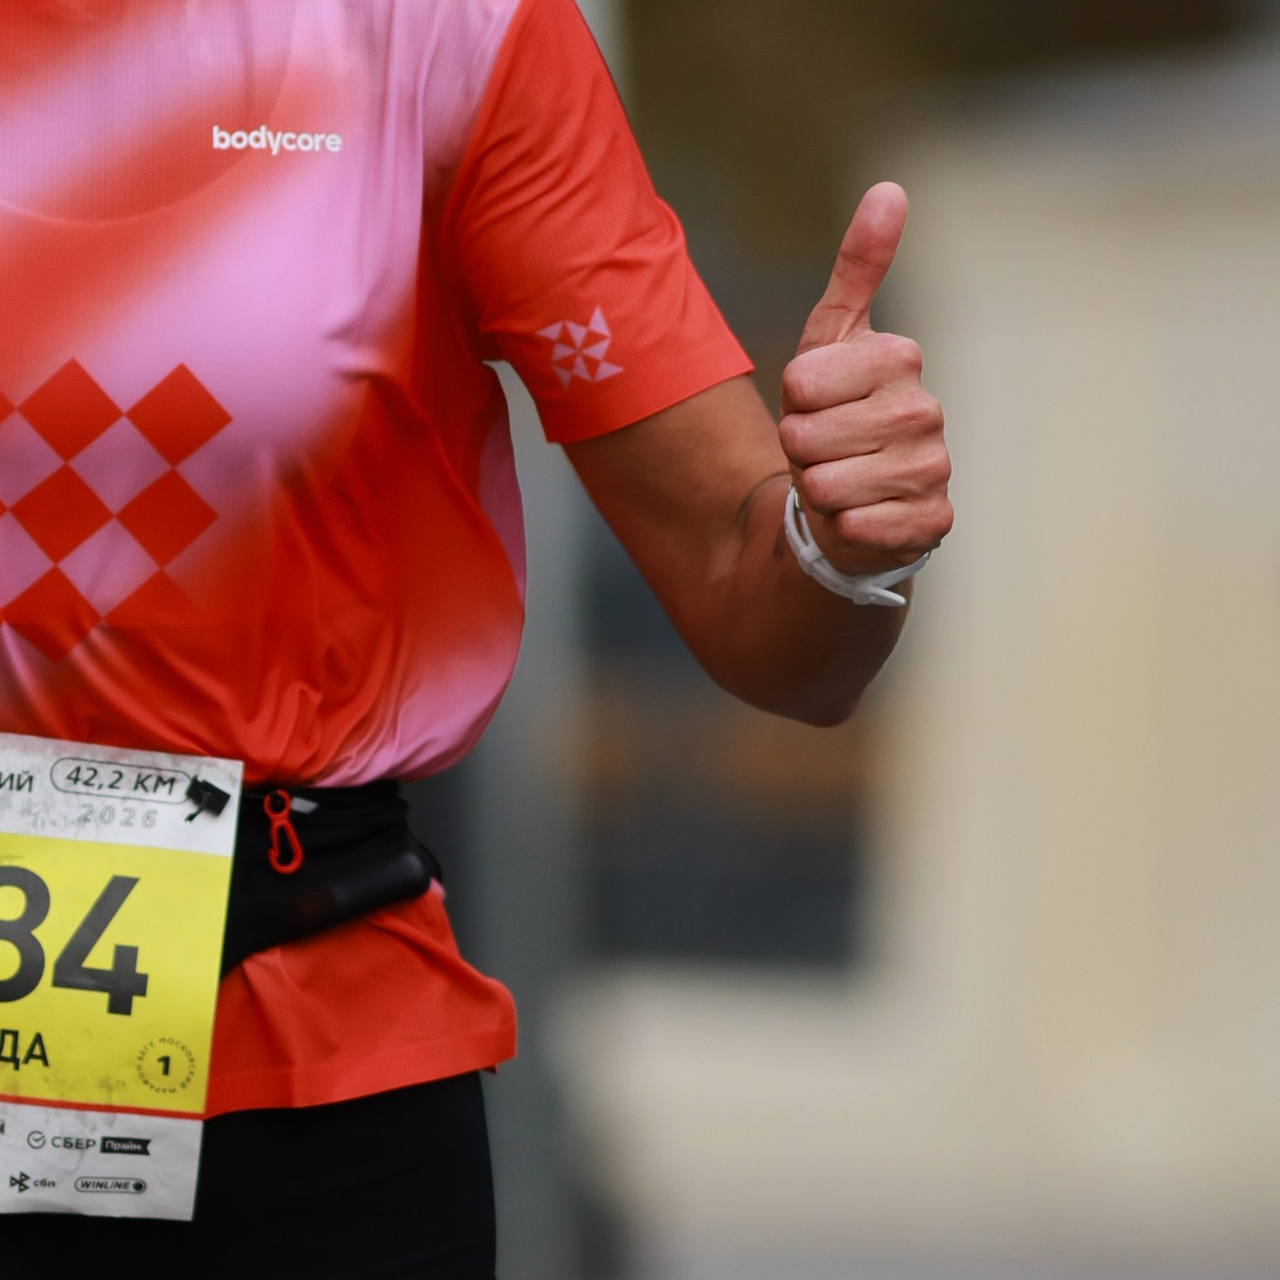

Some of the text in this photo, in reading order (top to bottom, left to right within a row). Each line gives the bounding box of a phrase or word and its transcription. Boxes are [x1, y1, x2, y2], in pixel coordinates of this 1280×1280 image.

[212, 124, 342, 156] bodycore
[66, 765, 123, 791] 42,2
[77, 803, 158, 828] 2026
[157, 1055, 170, 1076] 1
[51, 1136, 142, 1152] СБЕР Прайм
[80, 1180, 131, 1190] WINLINE
